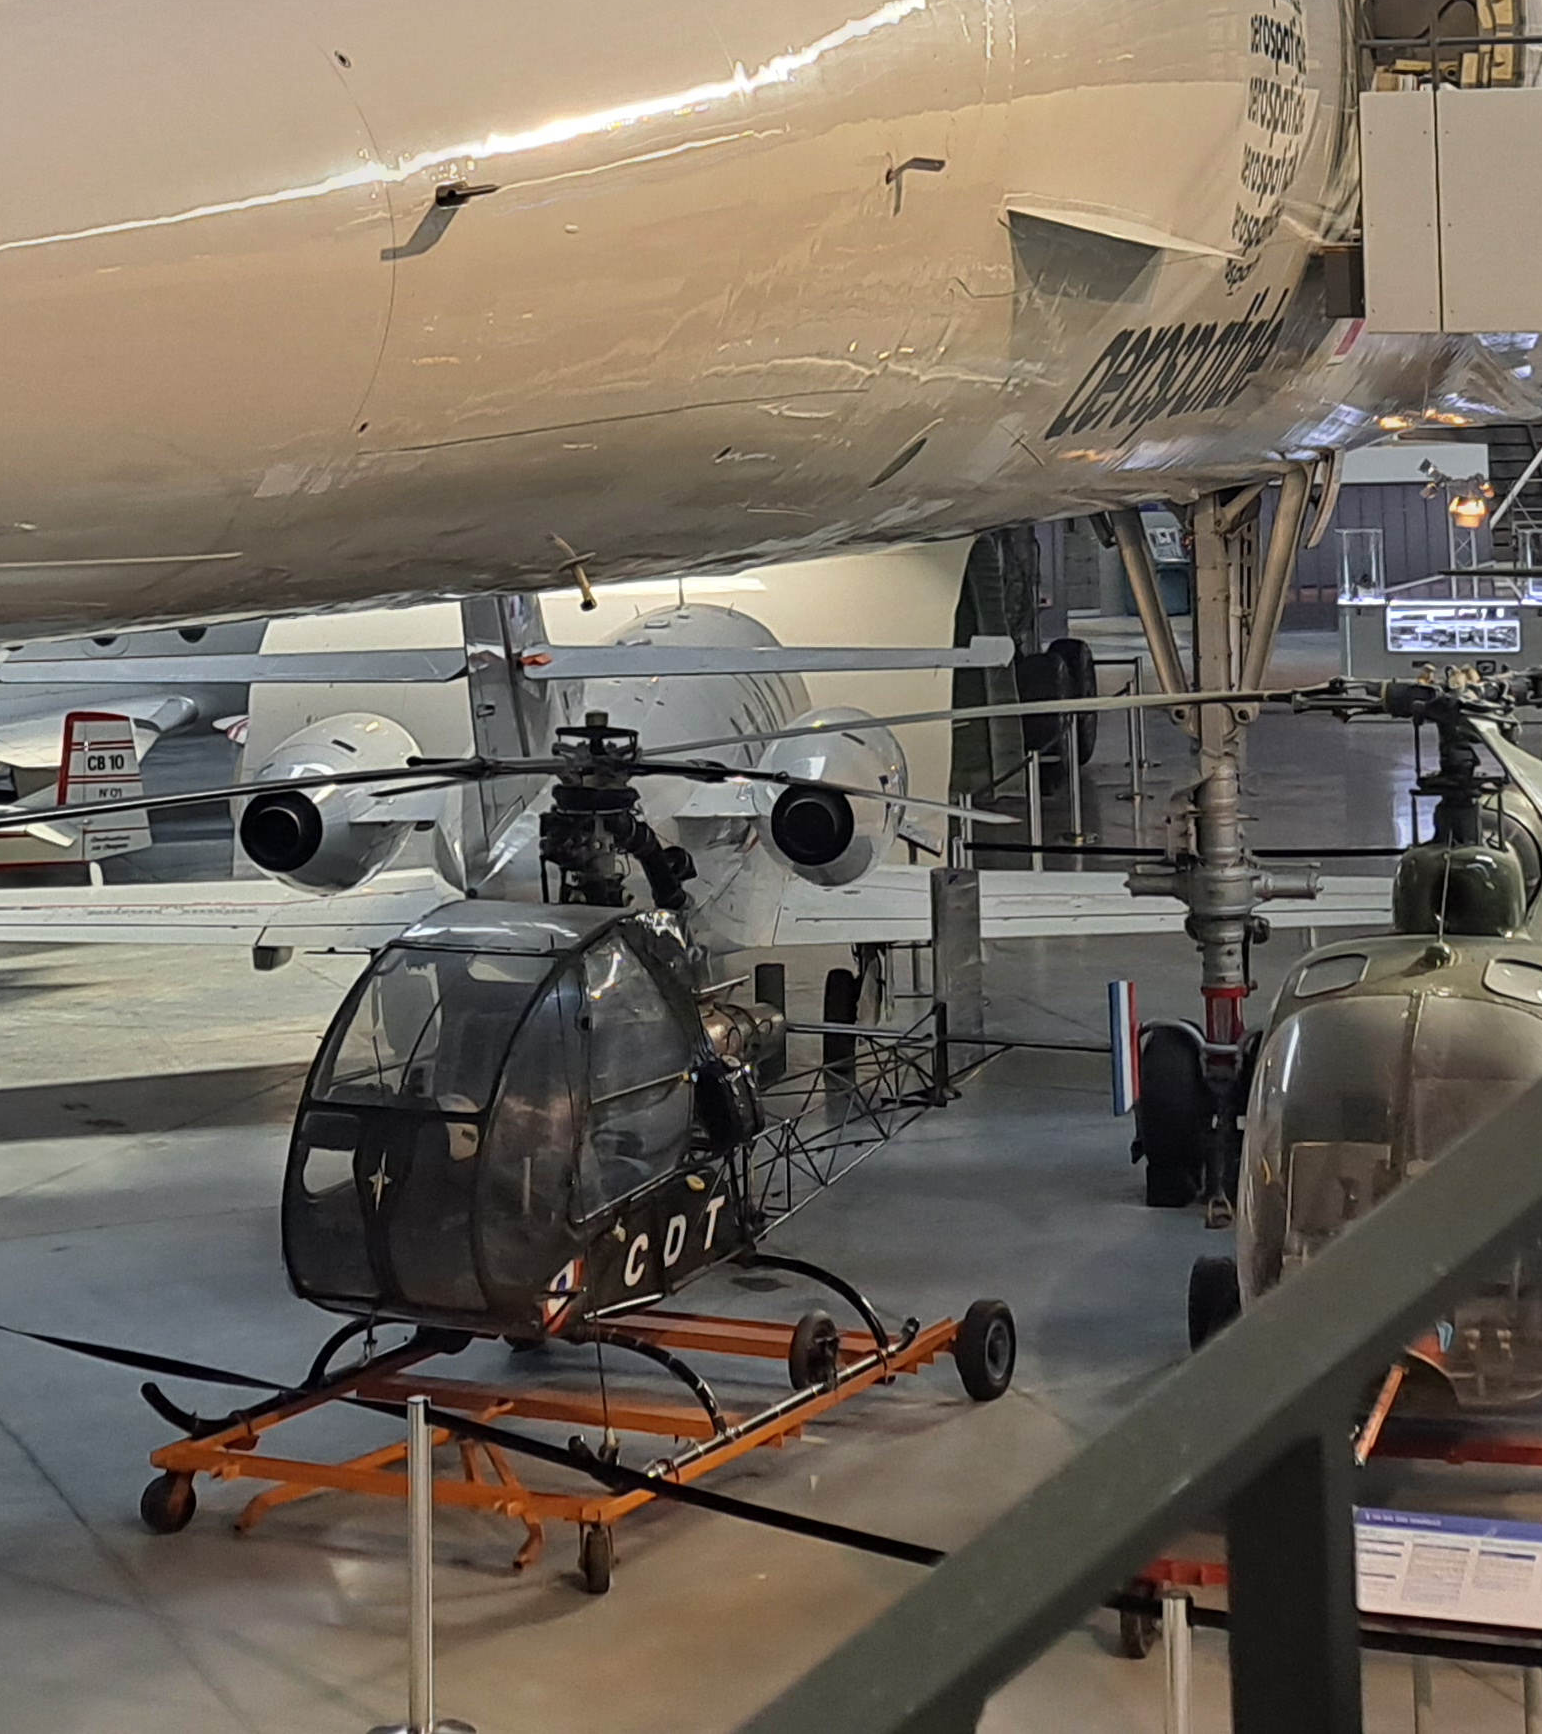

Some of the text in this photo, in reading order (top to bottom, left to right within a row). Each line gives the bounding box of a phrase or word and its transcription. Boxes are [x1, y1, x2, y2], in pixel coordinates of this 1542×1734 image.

[1044, 286, 1290, 450] aerospatiale
[87, 753, 125, 771] CB 10
[624, 1195, 726, 1287] CDT
